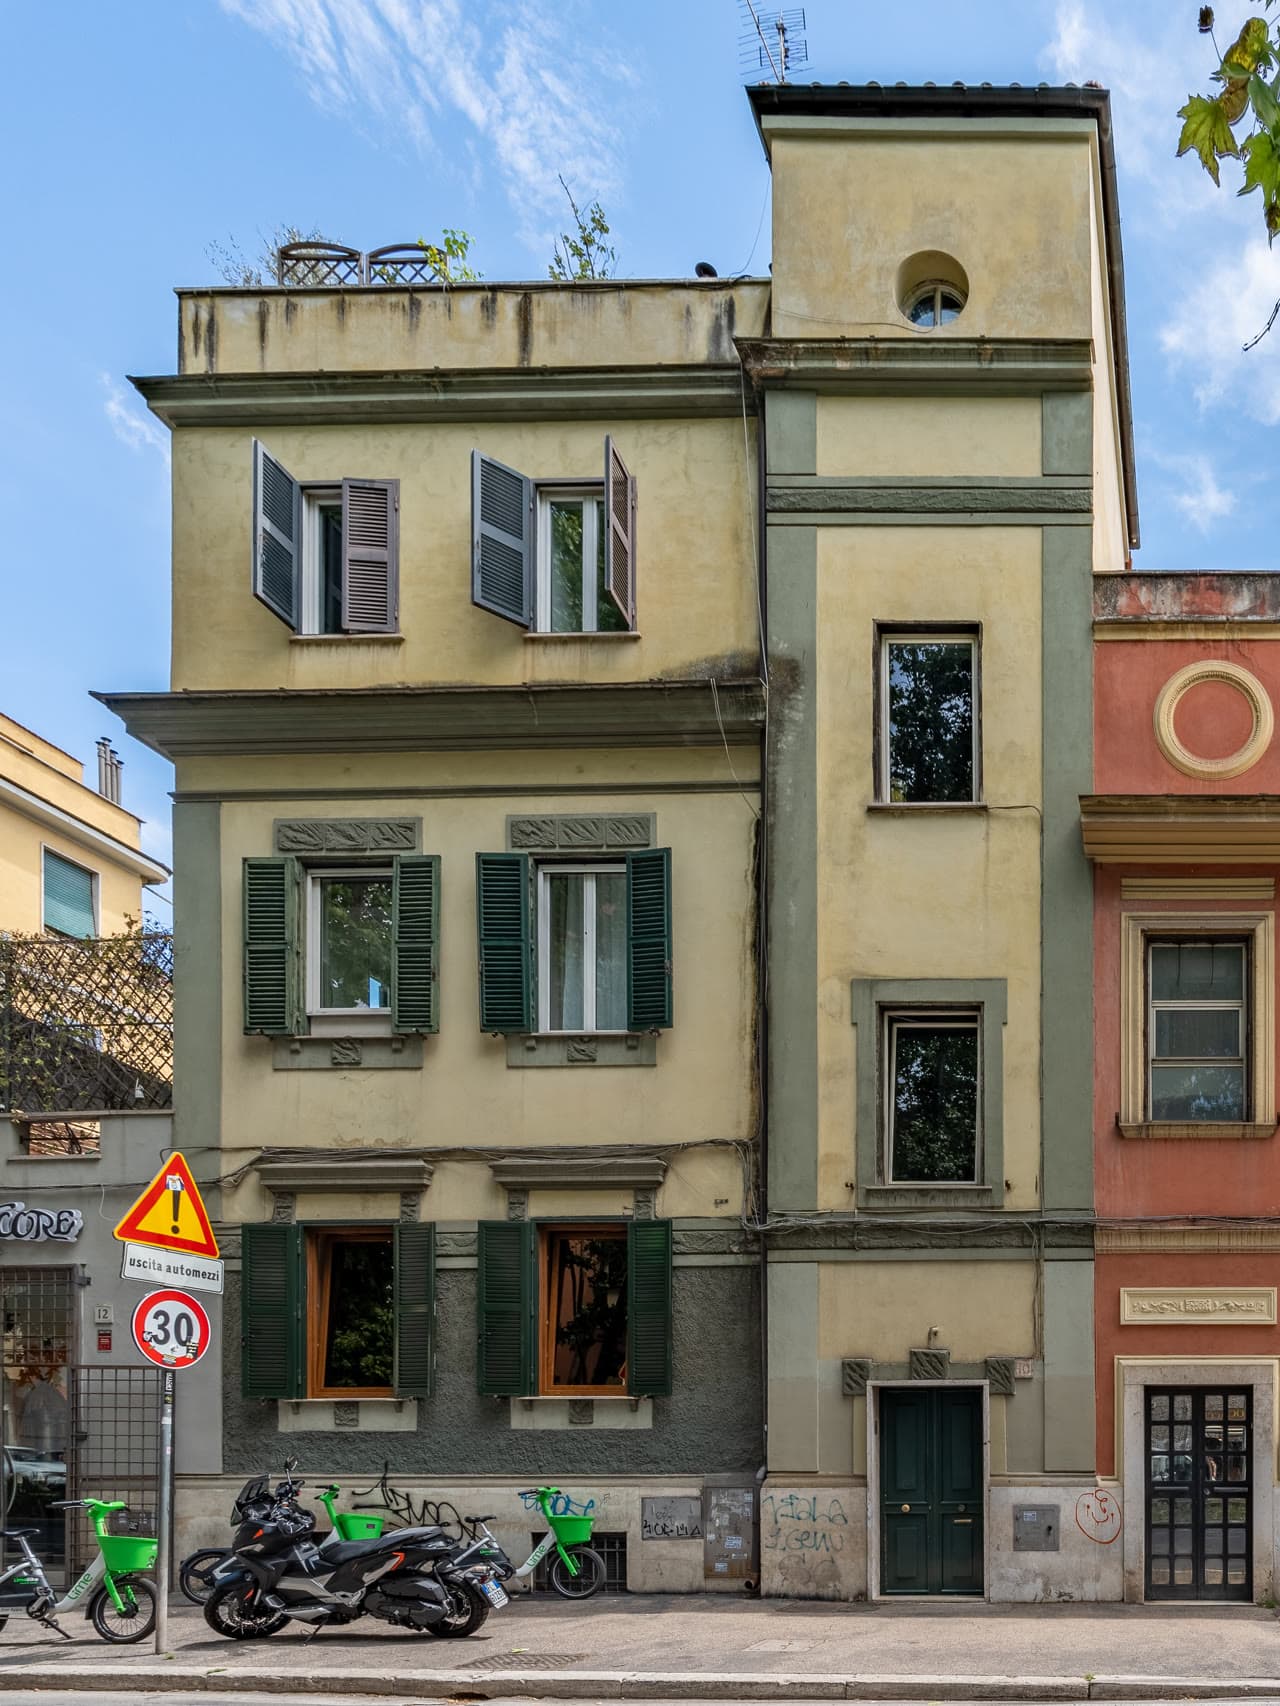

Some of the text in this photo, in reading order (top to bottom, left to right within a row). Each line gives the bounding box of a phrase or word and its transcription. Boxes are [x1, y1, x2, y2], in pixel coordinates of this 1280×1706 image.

[129, 1257, 220, 1282] uscita automezzi
[97, 1308, 109, 1320] 12
[153, 1309, 194, 1347] 30
[67, 1573, 93, 1600] Lime
